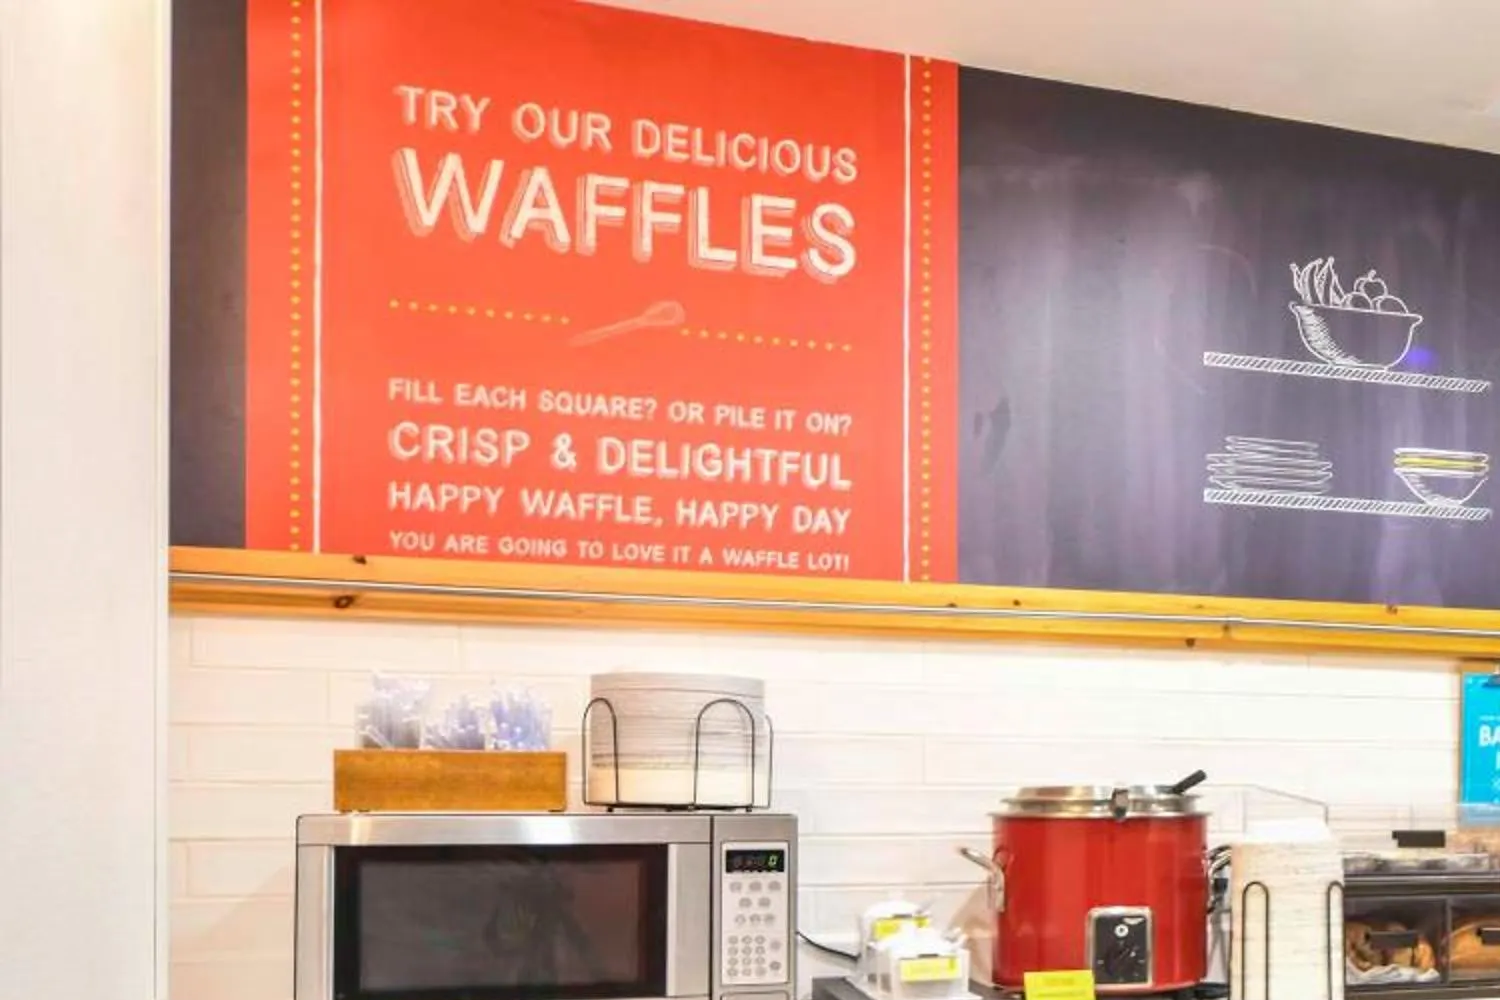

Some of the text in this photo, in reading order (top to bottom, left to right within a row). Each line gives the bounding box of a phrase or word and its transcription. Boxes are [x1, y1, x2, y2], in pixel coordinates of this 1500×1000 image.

[394, 85, 858, 183] TRY OUR DELICIOUS
[392, 147, 856, 283] WAFFLES
[388, 379, 852, 436] FILL EACH SQUARE? OR PILE IT ON?
[388, 421, 852, 490] CRISP & DELIGHTFUL
[388, 481, 851, 534] HAPPY WAFFLE, HAPPY DAY
[389, 531, 849, 572] YOU ARE GOING TO LOVE IT A WAFFLE LOT!
